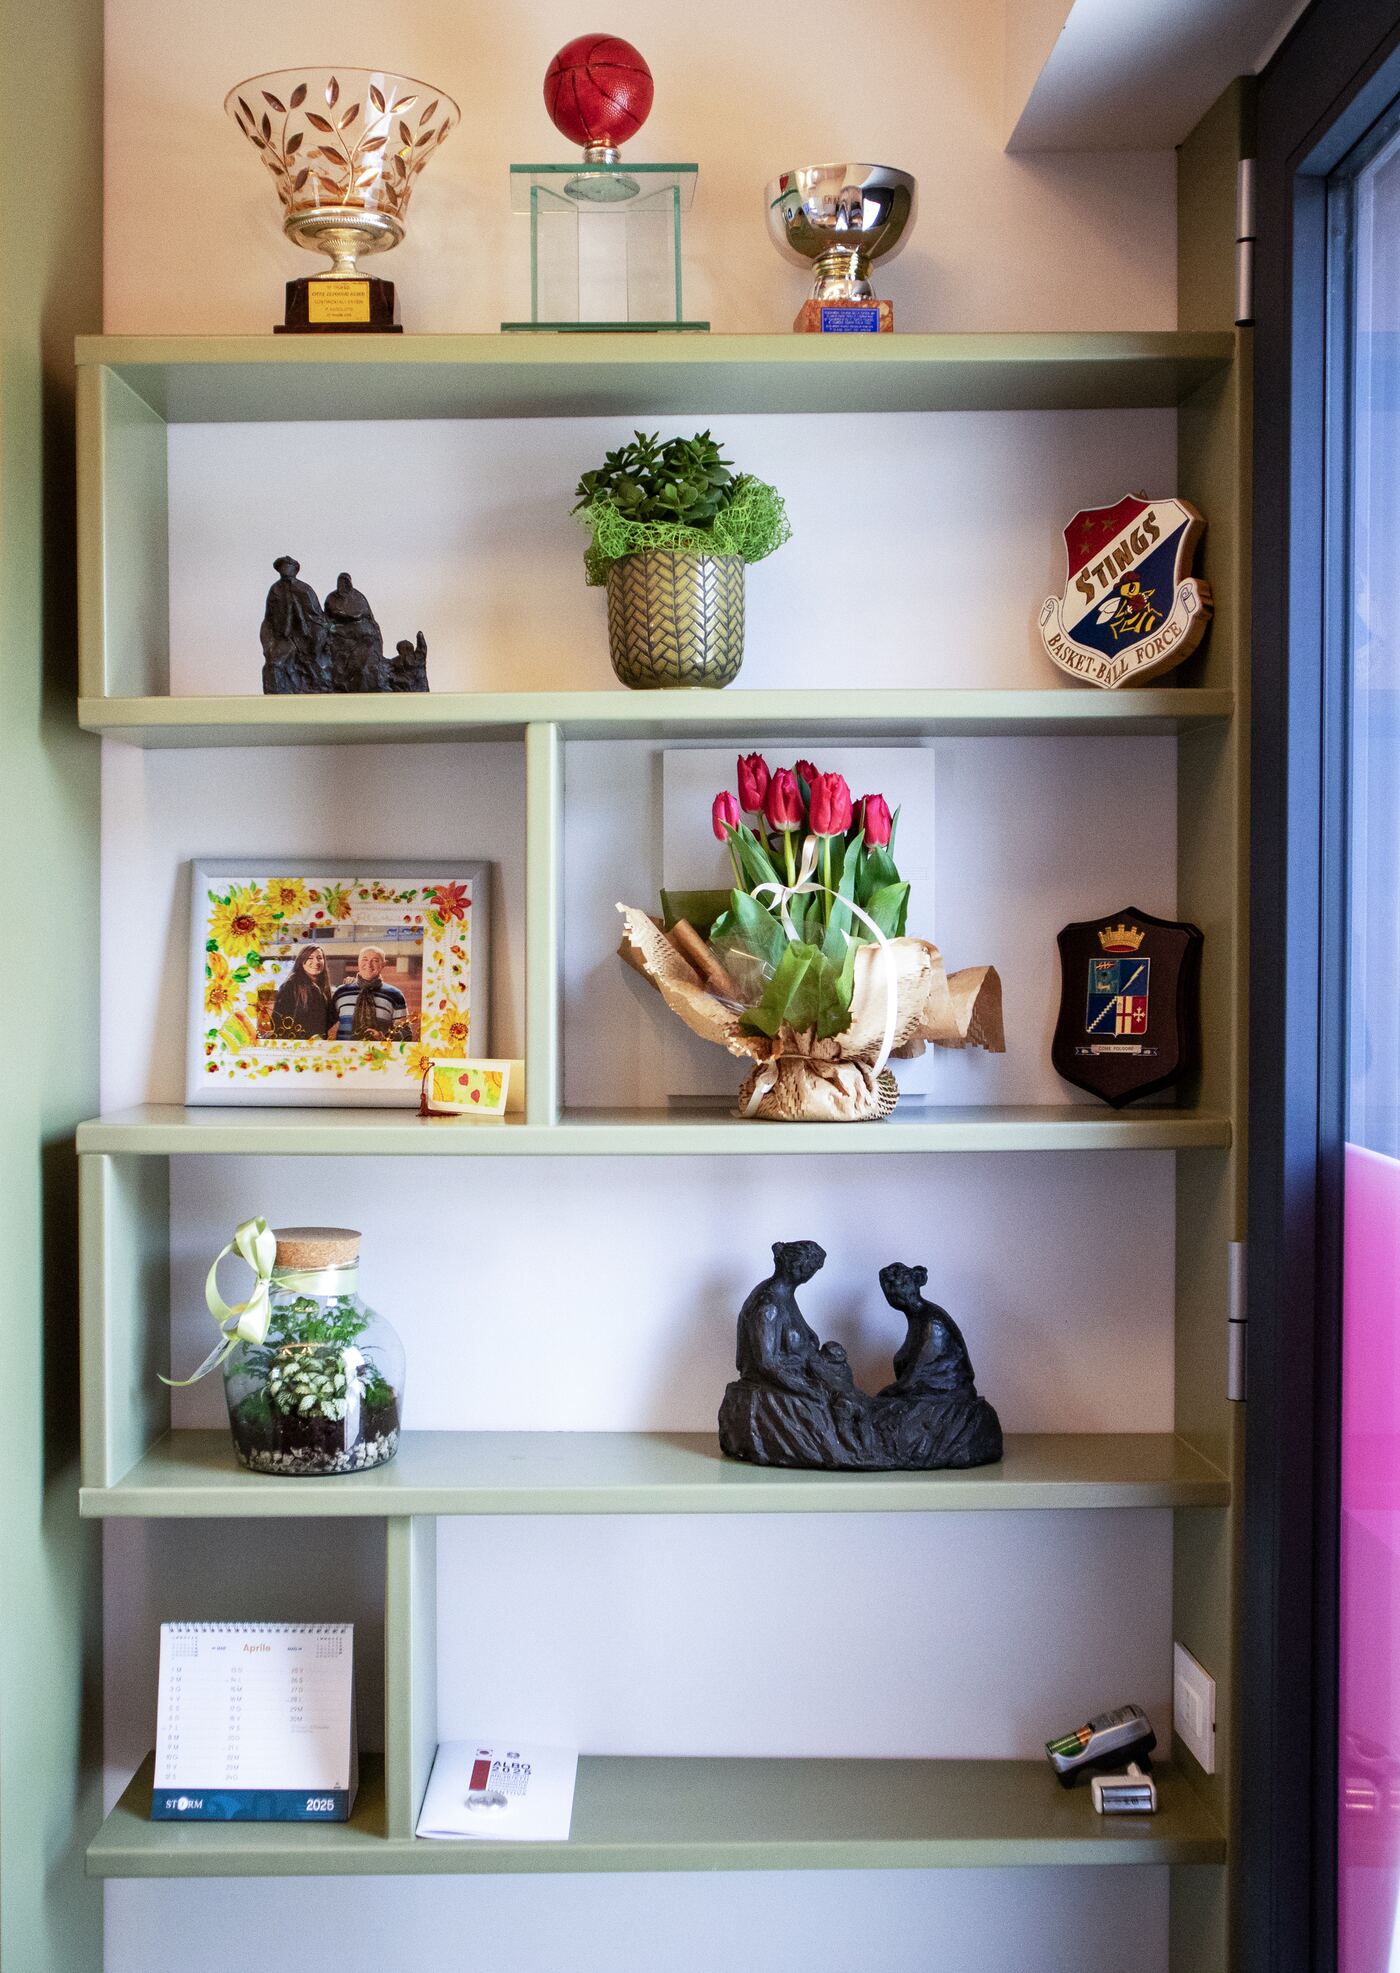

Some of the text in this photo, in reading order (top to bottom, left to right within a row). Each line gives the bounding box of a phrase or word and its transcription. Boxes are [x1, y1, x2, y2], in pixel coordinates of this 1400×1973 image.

[1075, 510, 1161, 606] STINGS
[1048, 622, 1182, 684] BASKET-BALL FORCE
[243, 1643, 271, 1654] Aprile
[492, 1766, 532, 1775] 2025
[493, 1761, 531, 1769] ALBO
[306, 1798, 335, 1811] 2025
